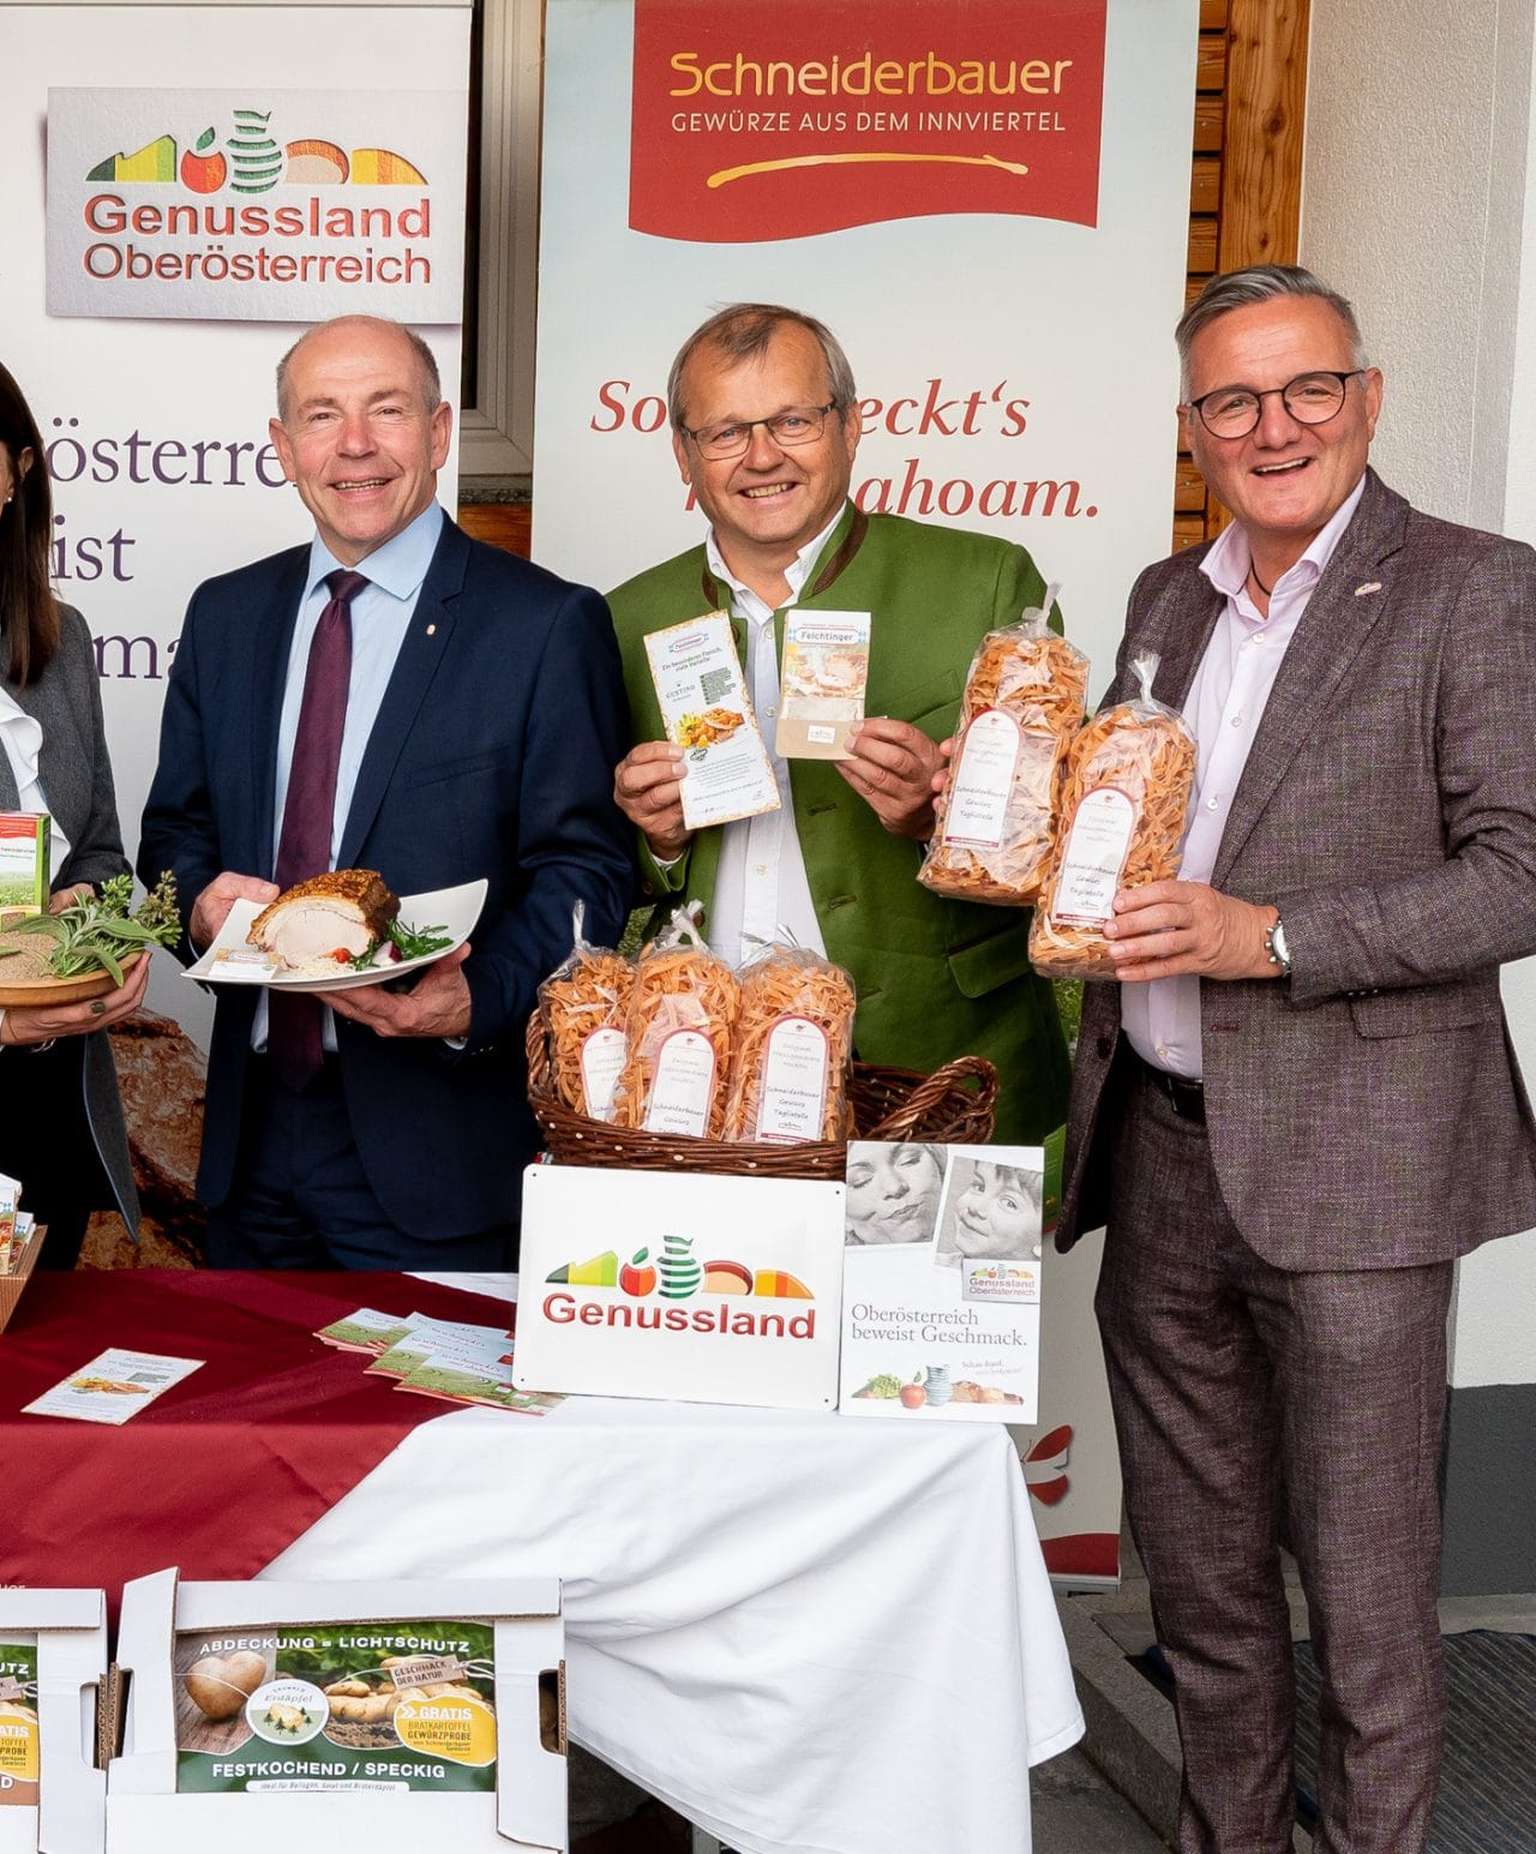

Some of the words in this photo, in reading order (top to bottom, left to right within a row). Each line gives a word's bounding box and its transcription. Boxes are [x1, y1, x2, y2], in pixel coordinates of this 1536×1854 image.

[670, 51, 1072, 97] Schneiderbauer
[671, 109, 791, 133] GEWÜRZE
[799, 112, 847, 132] AUS
[856, 112, 909, 132] DEM
[919, 111, 1066, 132] INNVIERTEL
[83, 194, 431, 239] Genussland
[82, 243, 432, 285] Oberösterreich
[863, 459, 1100, 519] ahoam.
[542, 1292, 816, 1340] Genussland
[851, 1303, 979, 1326] Oberösterreich
[851, 1322, 915, 1342] beweist
[921, 1325, 1028, 1346] Geschmack.
[199, 1637, 315, 1655] ABDECKUNG
[339, 1636, 470, 1652] LICHTSCHUTZ
[420, 1707, 473, 1719] GRATIS
[212, 1761, 347, 1777] FESTKOCHEND
[365, 1763, 446, 1778] SPECKIG
